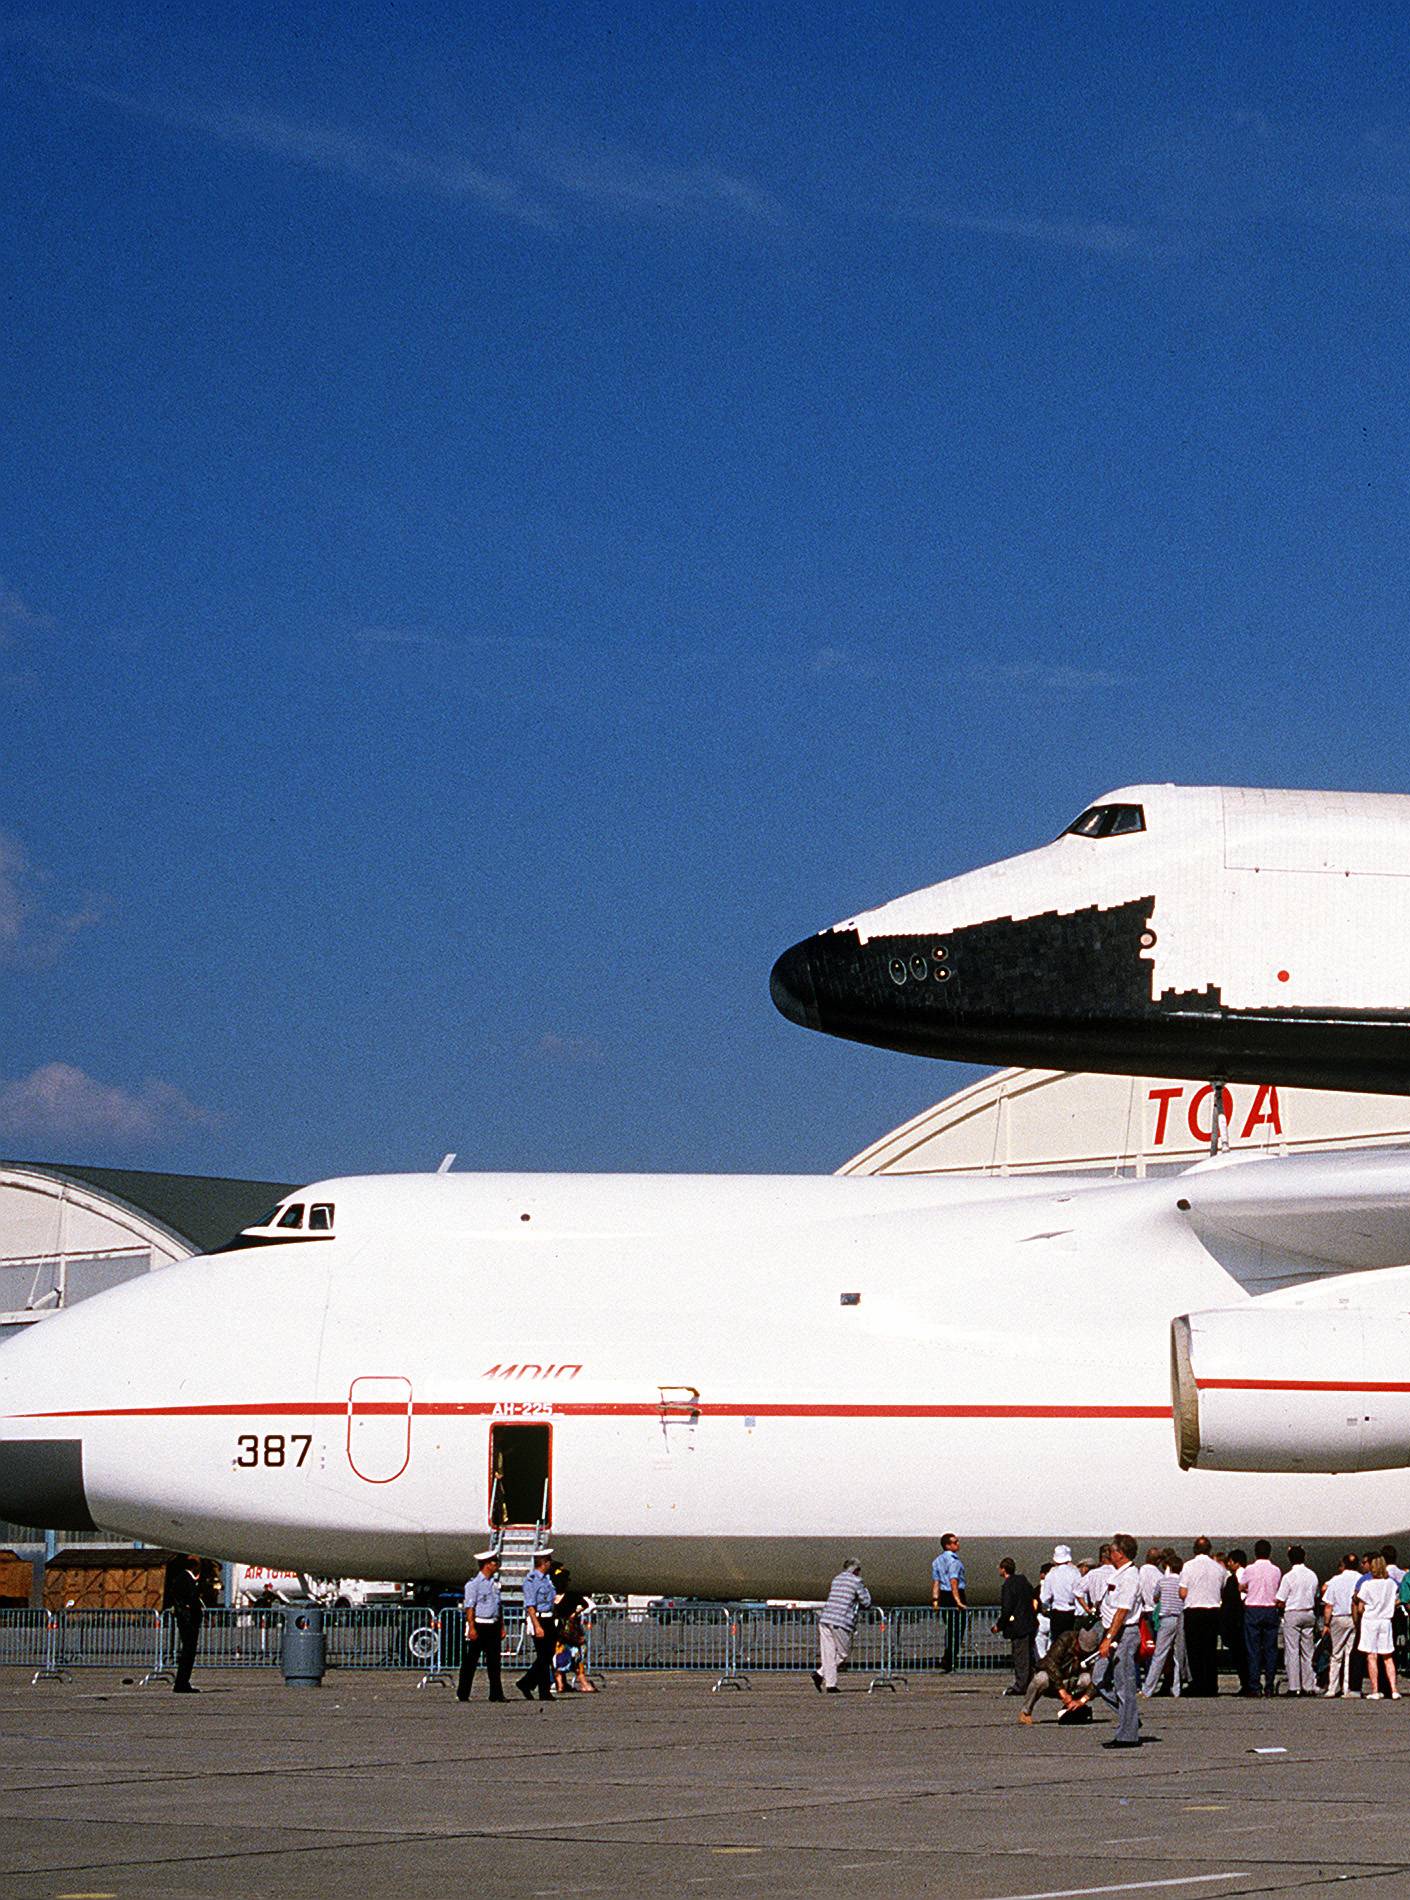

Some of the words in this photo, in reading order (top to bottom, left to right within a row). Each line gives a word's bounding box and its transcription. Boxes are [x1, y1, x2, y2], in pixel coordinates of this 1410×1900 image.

[1148, 1084, 1283, 1146] TOA
[237, 1434, 313, 1468] 387
[244, 1566, 263, 1580] AIR
